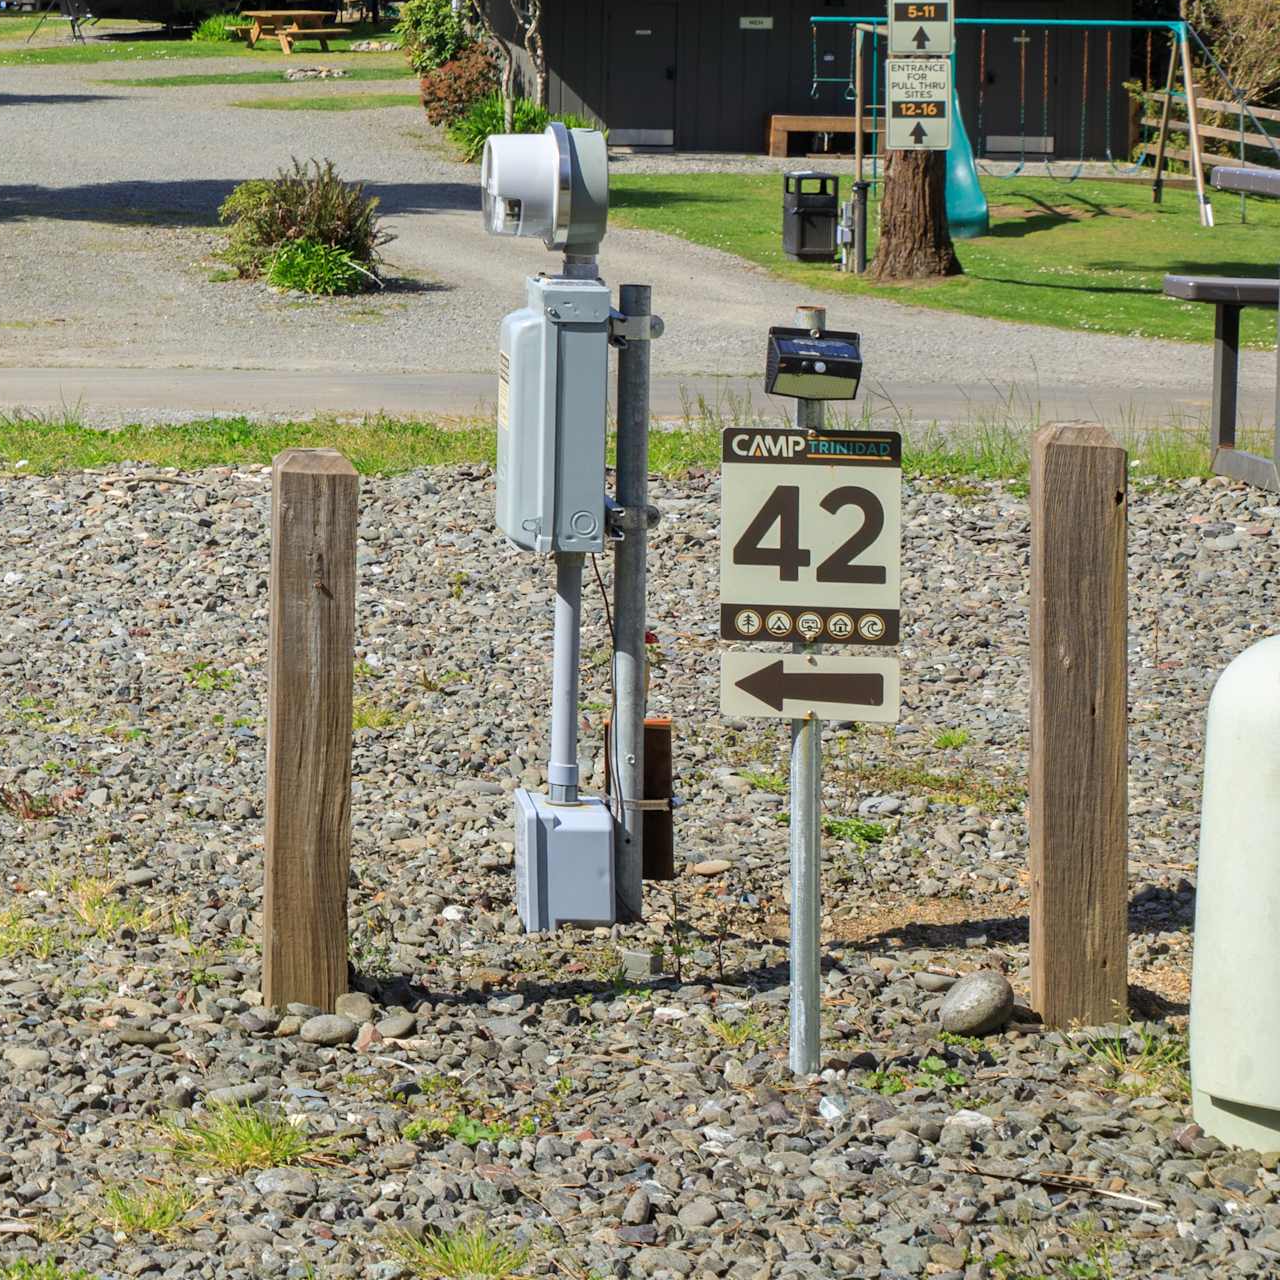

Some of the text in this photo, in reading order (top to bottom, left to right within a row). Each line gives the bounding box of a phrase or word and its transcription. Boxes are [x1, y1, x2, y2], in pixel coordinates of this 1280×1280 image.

[907, 5, 936, 19] 5-11
[891, 64, 945, 72] ENTRANCE
[907, 73, 928, 81] FOR
[892, 82, 946, 90] PULL THRU
[904, 90, 933, 99] SITES
[900, 103, 937, 116] 12-16
[732, 434, 890, 458] CAMP TRINIDAD
[733, 485, 887, 585] 42
